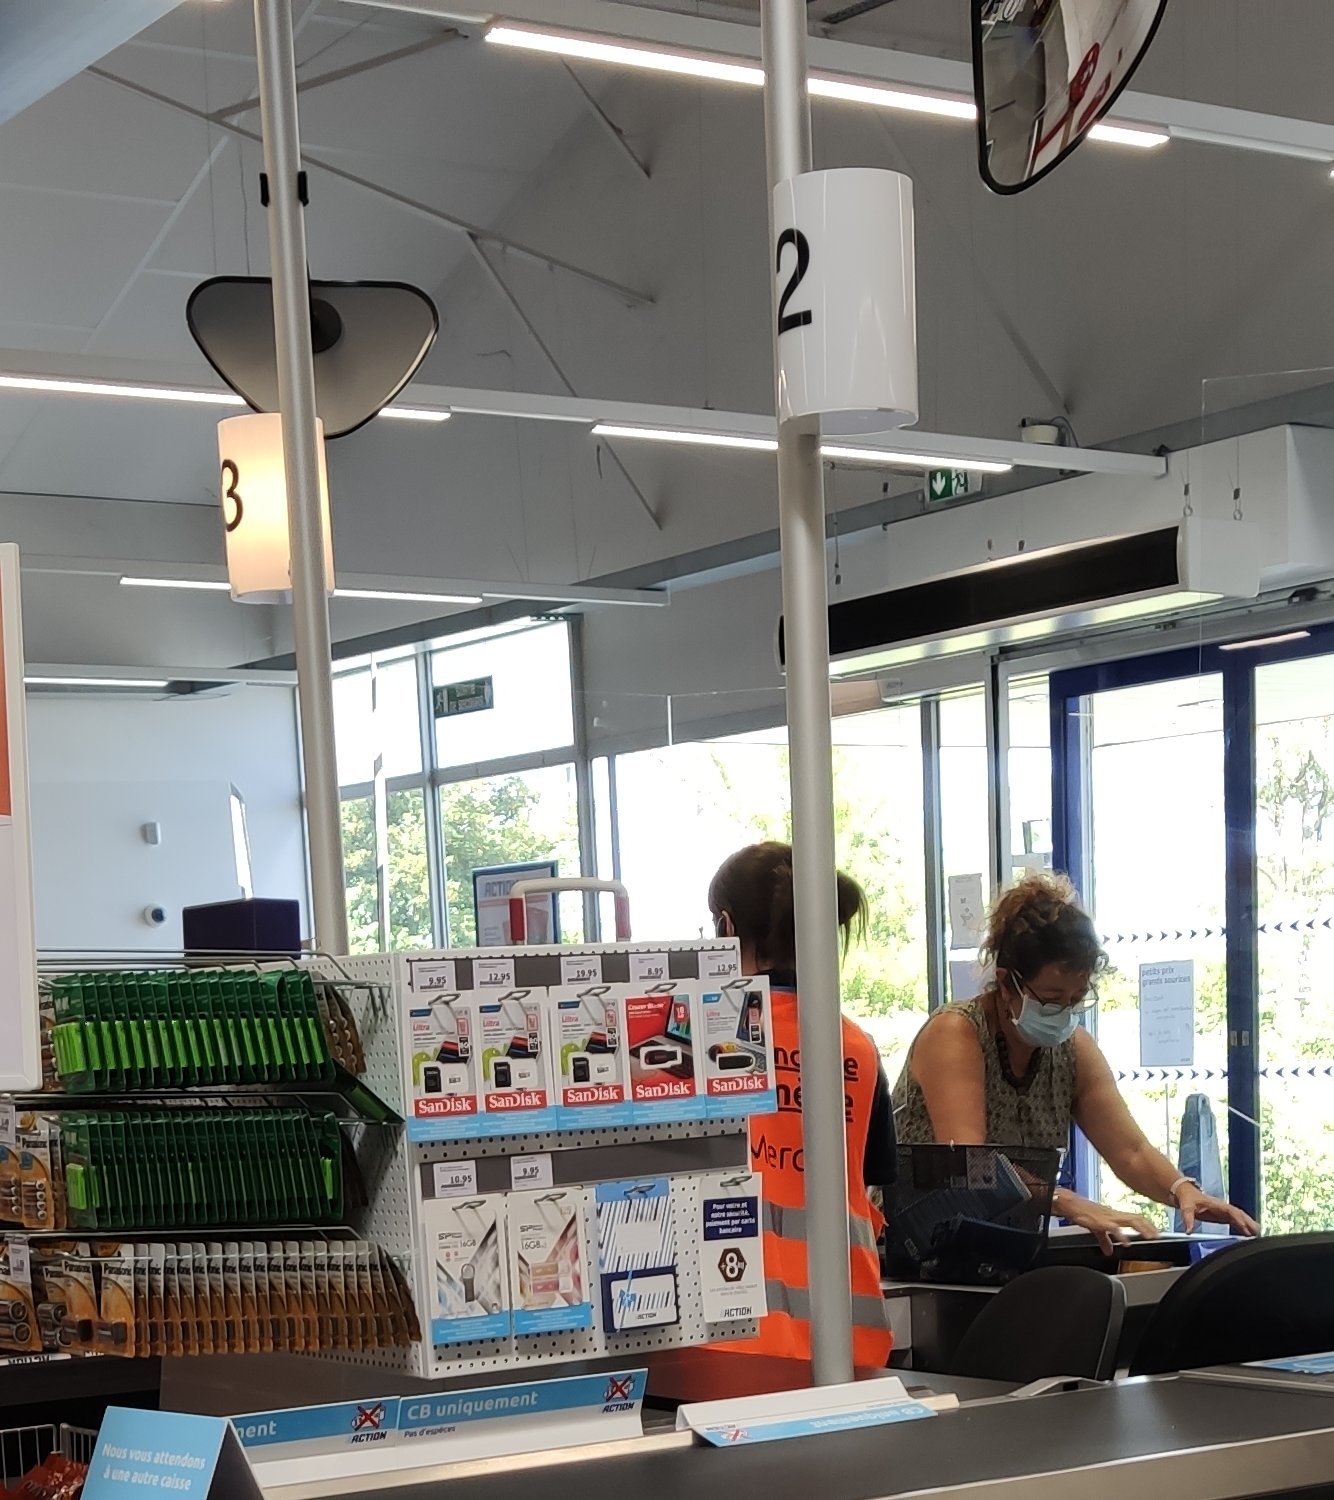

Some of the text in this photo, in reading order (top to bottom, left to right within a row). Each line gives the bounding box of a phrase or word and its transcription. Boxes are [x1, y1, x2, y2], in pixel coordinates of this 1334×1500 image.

[777, 228, 812, 335] 2
[222, 459, 243, 532] 3
[636, 1081, 691, 1099] SanDisk
[712, 1076, 765, 1093] SanDisk
[489, 1093, 542, 1109] SanDisk
[567, 1086, 619, 1103] SanDisk
[418, 1099, 472, 1114] SanDisk
[724, 1306, 752, 1318] ACTION
[407, 1391, 538, 1421] CB uniquement
[602, 1401, 635, 1414] ACTION
[351, 1430, 388, 1444] ACTION
[404, 1429, 419, 1439] Pas
[102, 1443, 206, 1471] Nous vous attendons
[103, 1464, 192, 1491] à une autre caisse
